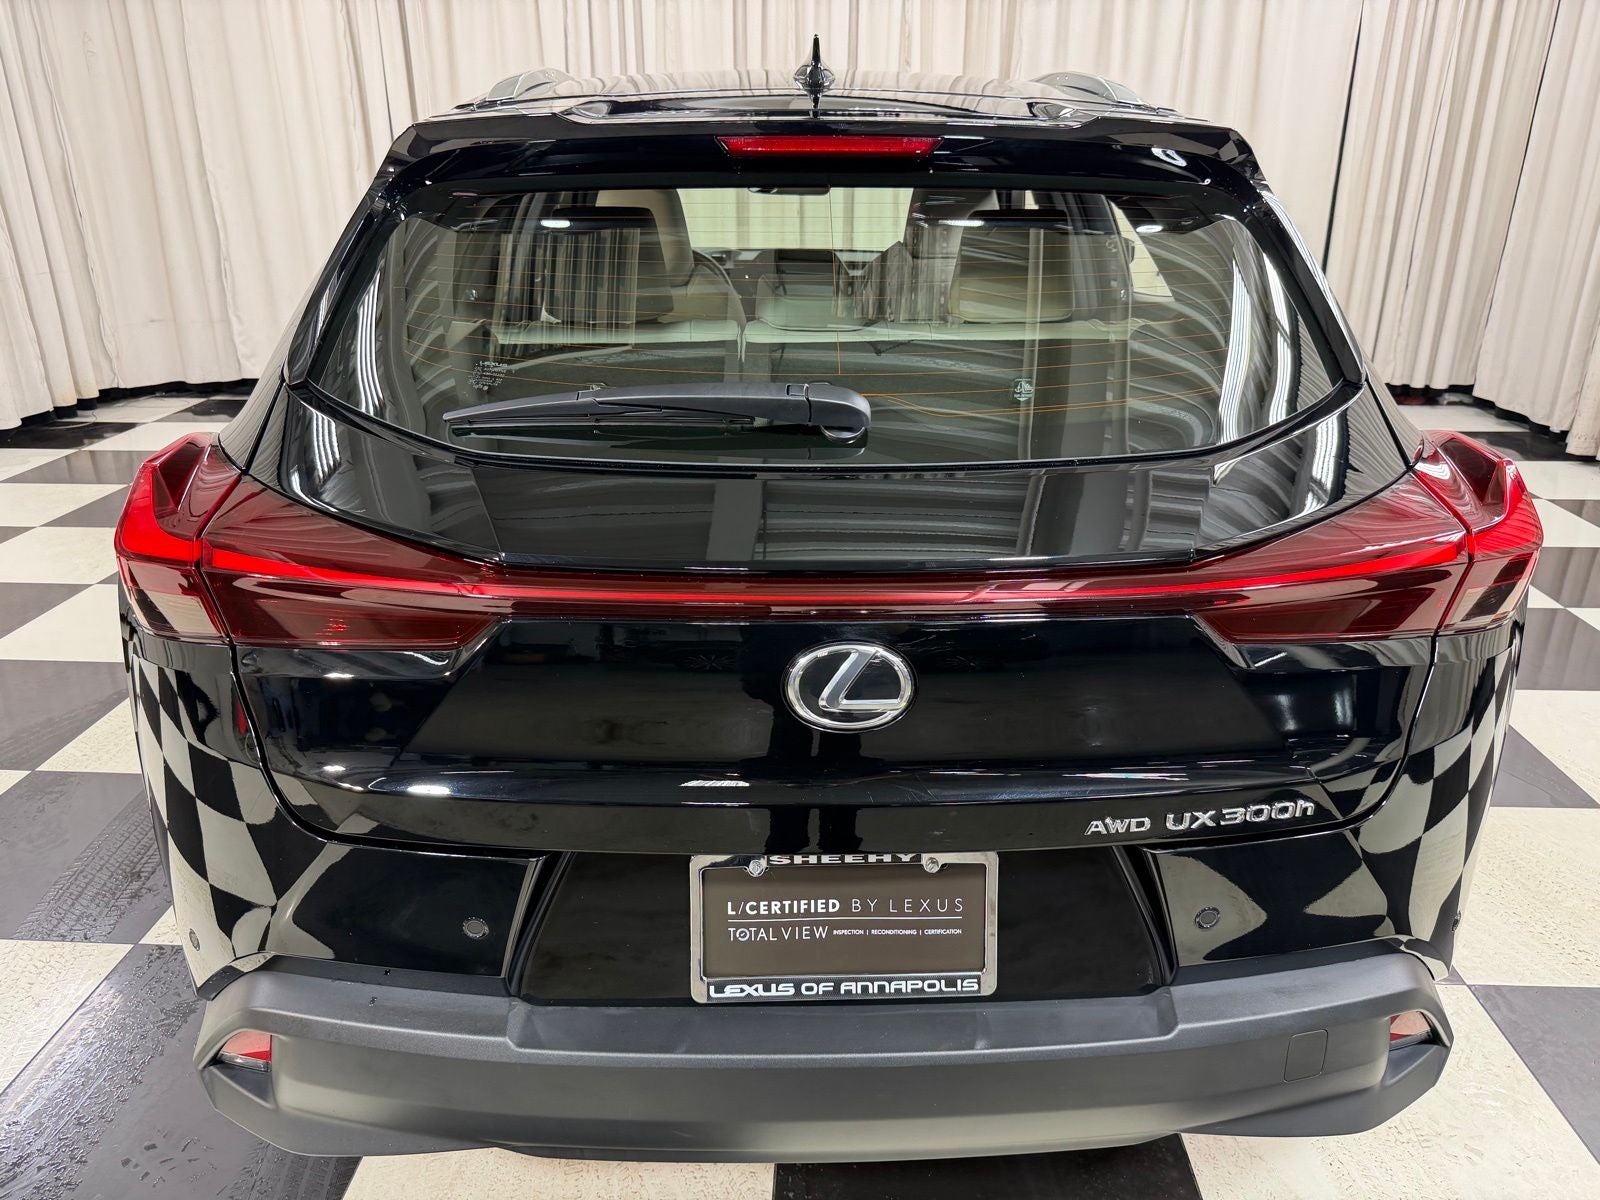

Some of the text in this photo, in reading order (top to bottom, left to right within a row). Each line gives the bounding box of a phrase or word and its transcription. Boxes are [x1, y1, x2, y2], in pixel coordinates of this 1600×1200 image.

[1085, 816, 1151, 835] AWD
[769, 853, 917, 865] SHEEHY
[727, 898, 963, 915] L/CERTIFIED BY LEXUS
[709, 978, 979, 998] LEXUS OF ANNAPOLIS
